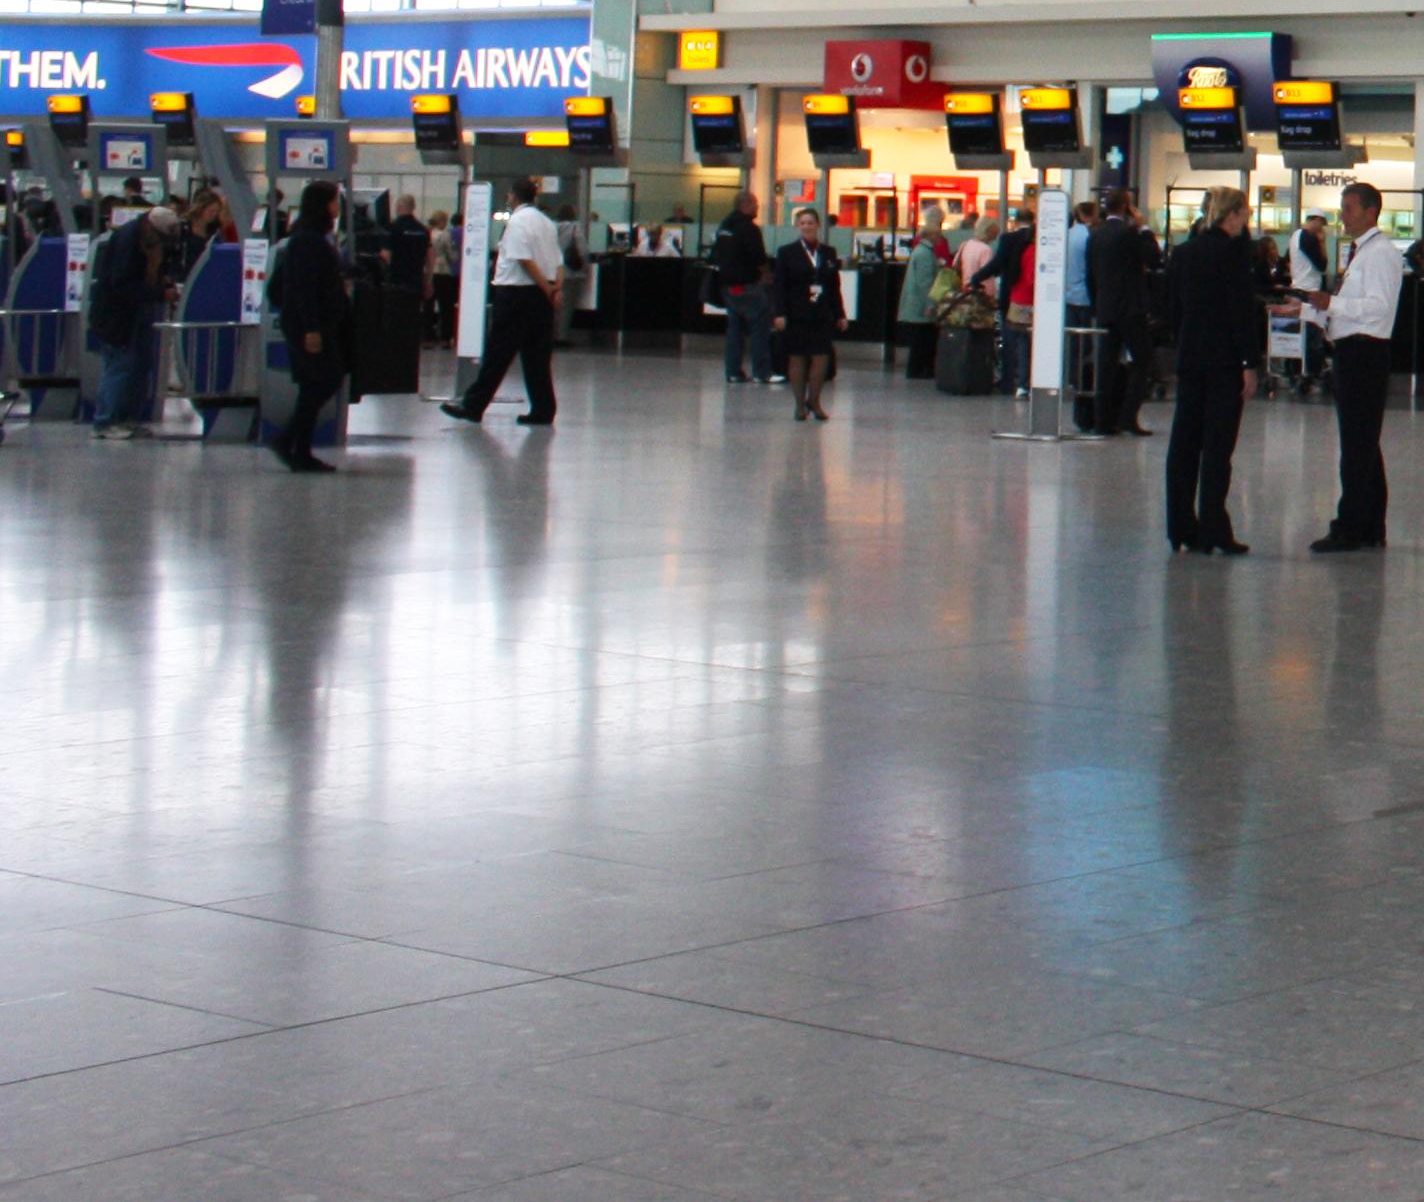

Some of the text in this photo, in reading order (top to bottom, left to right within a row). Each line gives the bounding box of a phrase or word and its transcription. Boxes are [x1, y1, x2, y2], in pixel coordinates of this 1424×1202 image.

[340, 46, 592, 91] RITISH AIRWAYS
[1304, 170, 1358, 186] toiletries
